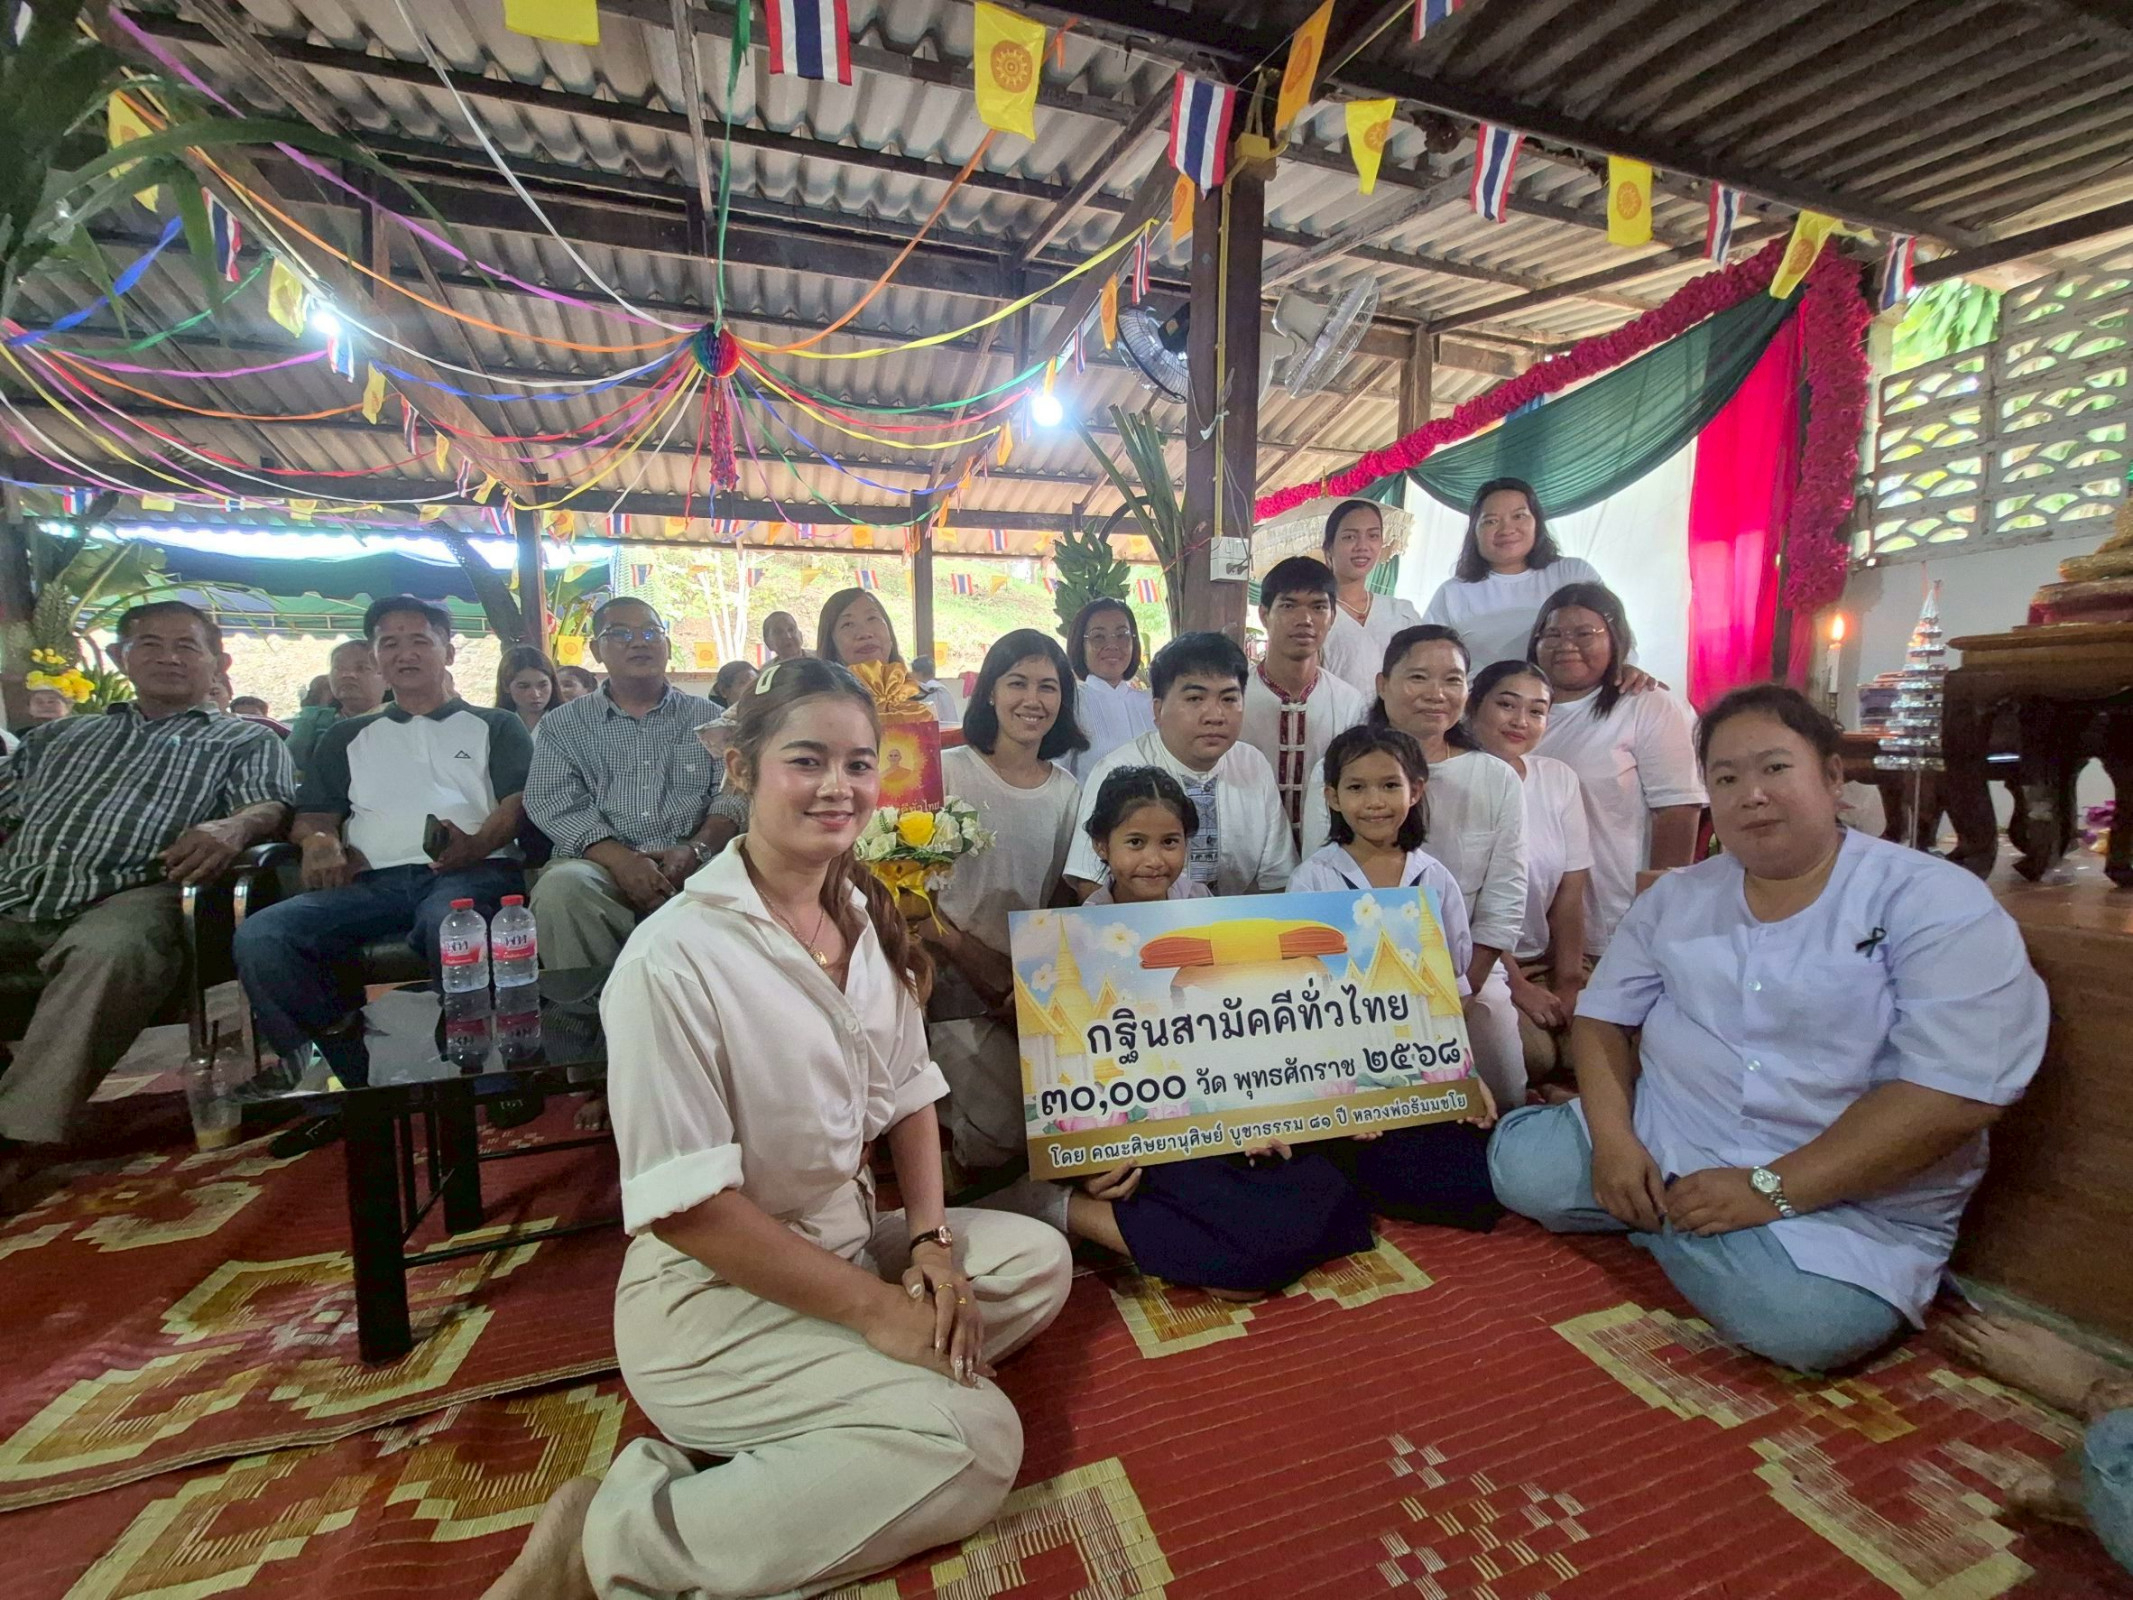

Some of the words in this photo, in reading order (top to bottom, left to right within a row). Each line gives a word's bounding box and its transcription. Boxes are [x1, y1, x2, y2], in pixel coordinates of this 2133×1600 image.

[1087, 977, 1409, 1064] กฐินสามัคคีทั่วไทย
[1041, 1075, 1186, 1115] ๓๐,๐๐๐
[1196, 1067, 1227, 1095] วัด
[1233, 1057, 1356, 1100] พุทธศักราช
[1362, 1037, 1461, 1073] ๒๕๖๘
[1051, 1146, 1085, 1166] โดย
[1092, 1123, 1223, 1162] คณะศิษยานุศิษย์
[1229, 1119, 1304, 1147] บูชาธรรม
[1309, 1115, 1332, 1128] ๘๑
[1337, 1107, 1348, 1125] ปี
[1352, 1092, 1467, 1122] หลวงพ่อธัมมชโย
